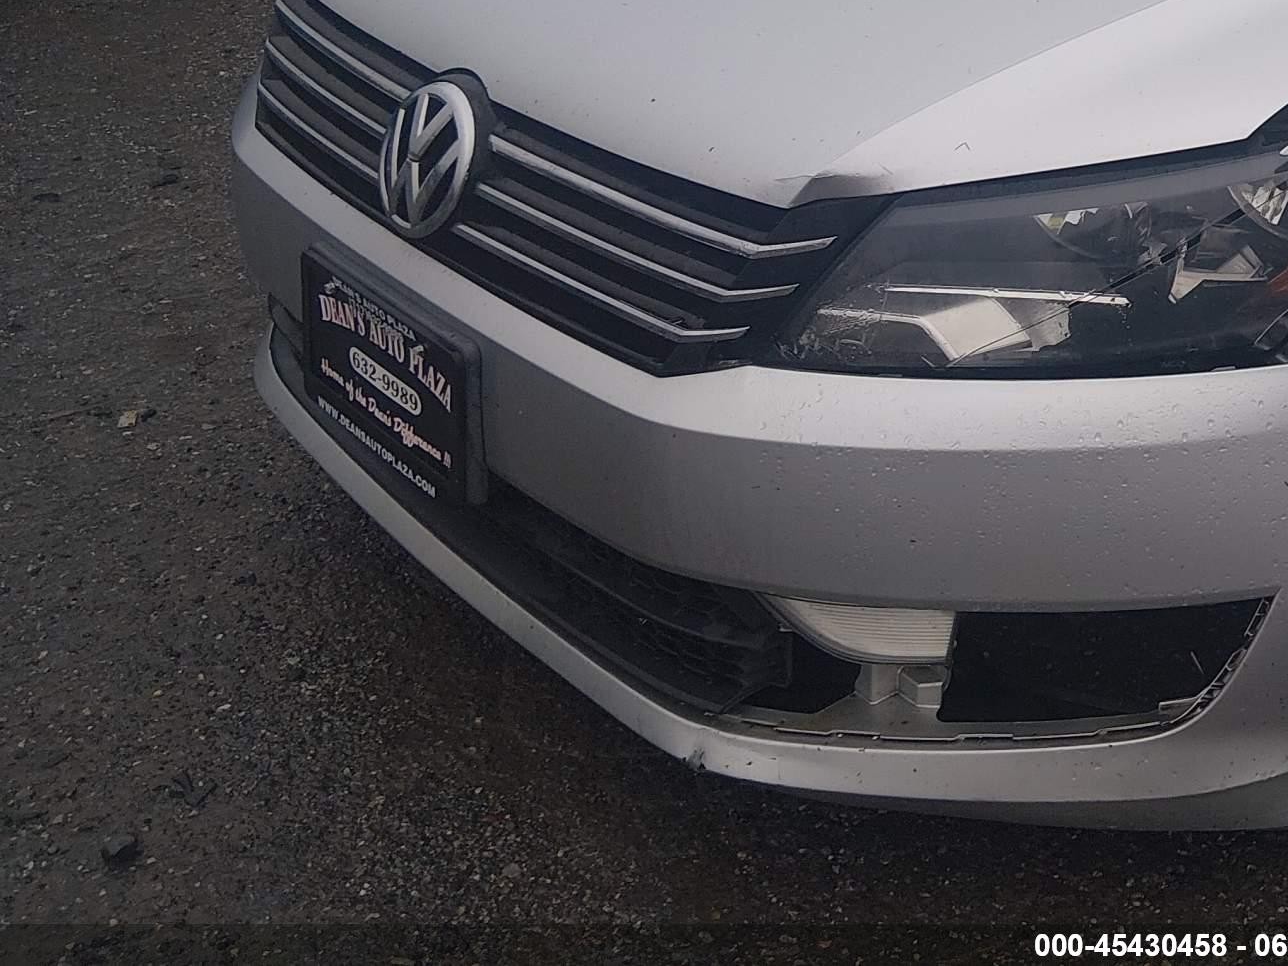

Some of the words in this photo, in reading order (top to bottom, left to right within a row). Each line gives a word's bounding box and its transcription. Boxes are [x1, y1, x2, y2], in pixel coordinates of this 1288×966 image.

[318, 294, 366, 337] DEAN'S
[369, 319, 406, 364] AUTO
[408, 346, 452, 413] PLAZA
[351, 351, 419, 411] 632-9989
[317, 396, 436, 498] WWW.DEANSAUTOPLAZA.COM
[321, 358, 345, 386] Home
[393, 417, 442, 460] Difference
